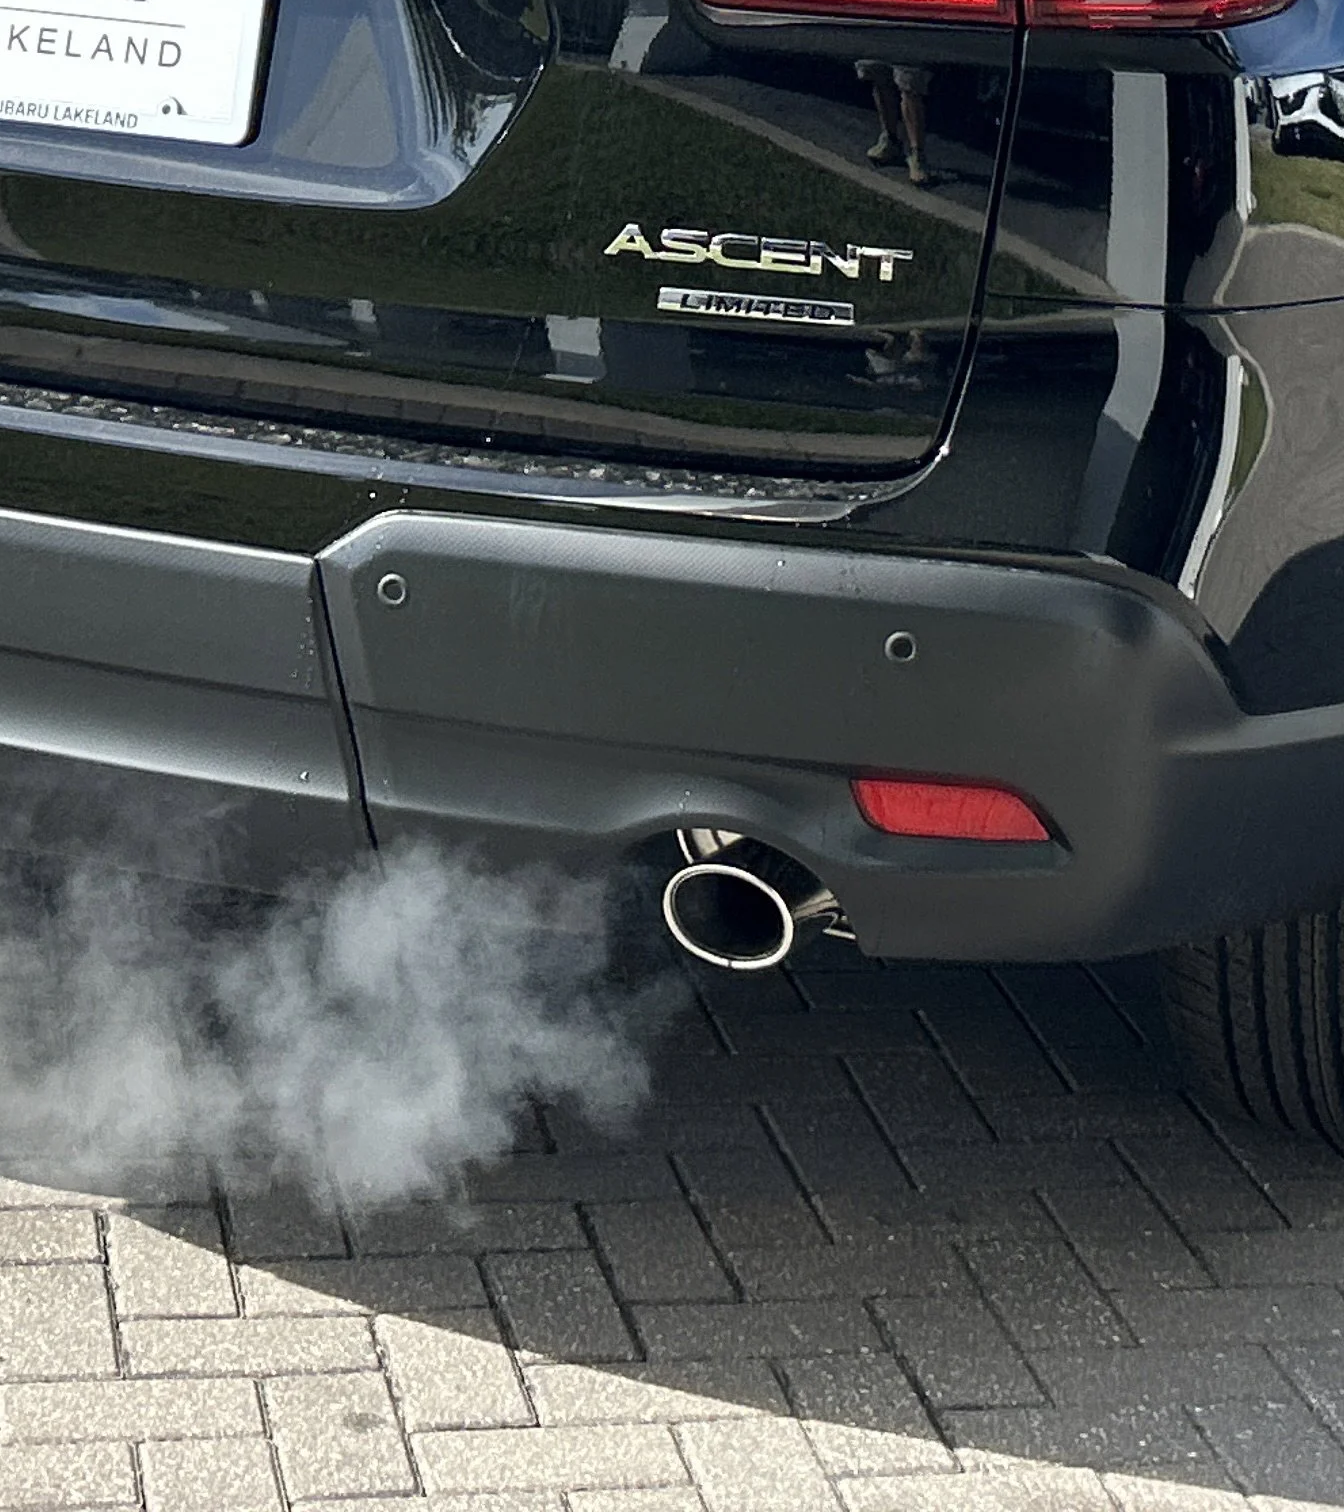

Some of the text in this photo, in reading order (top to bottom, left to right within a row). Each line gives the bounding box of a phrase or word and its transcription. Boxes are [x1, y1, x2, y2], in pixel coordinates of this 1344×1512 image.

[53, 104, 139, 130] LAKELAND
[604, 223, 914, 281] ASCENT
[679, 293, 836, 320] LIMITED
